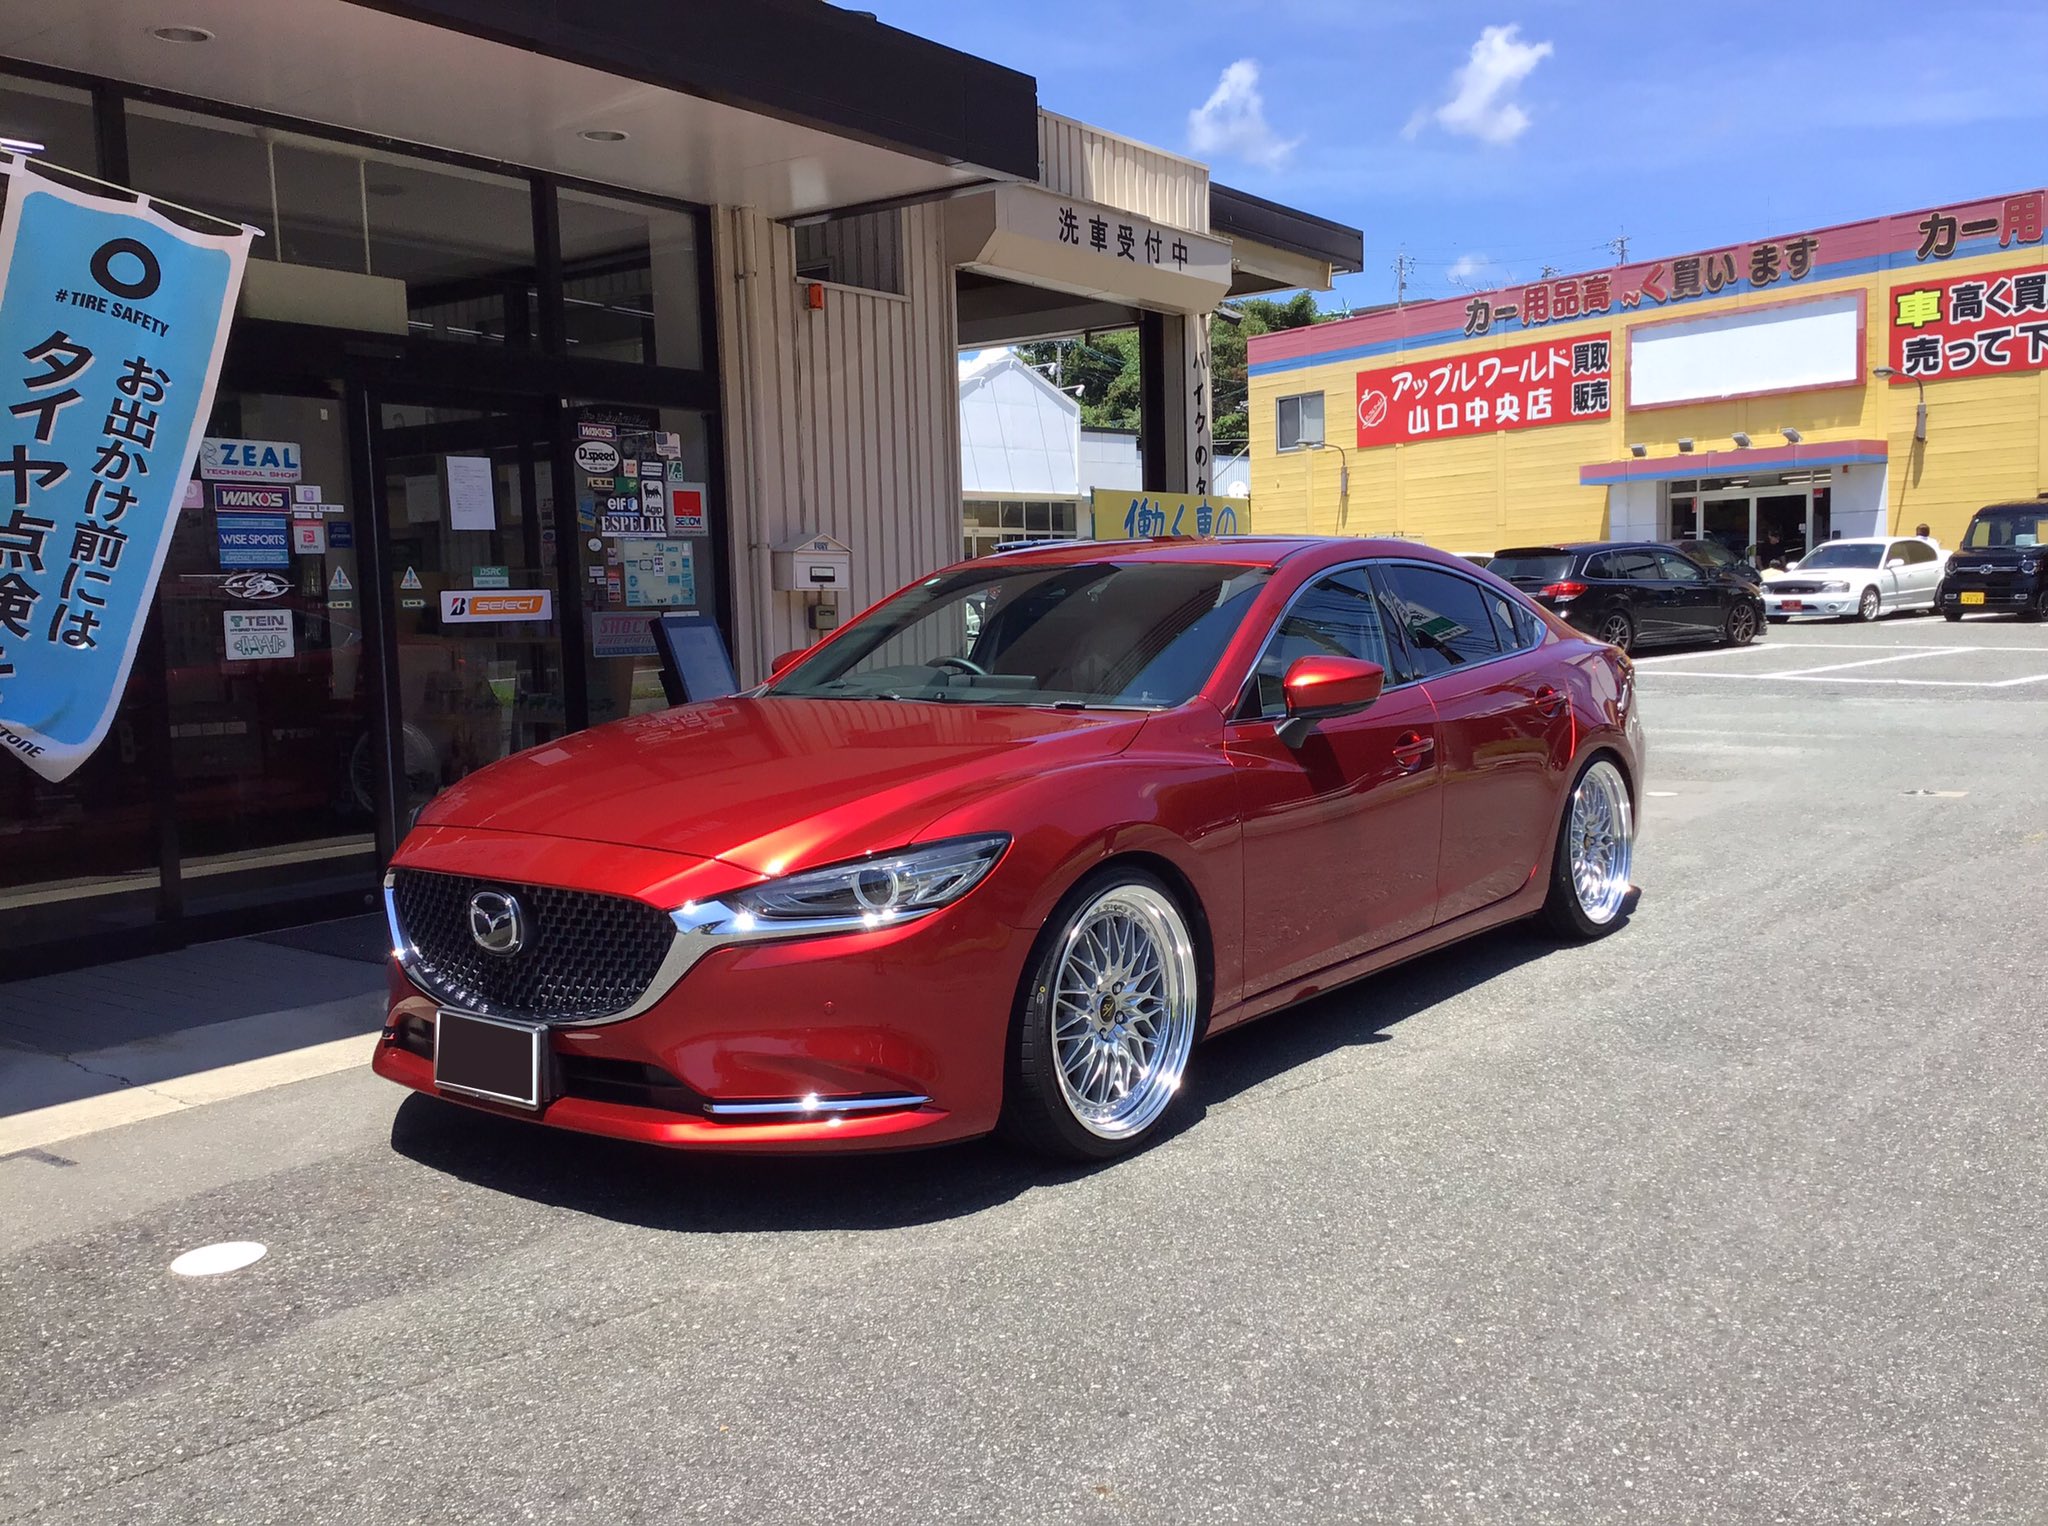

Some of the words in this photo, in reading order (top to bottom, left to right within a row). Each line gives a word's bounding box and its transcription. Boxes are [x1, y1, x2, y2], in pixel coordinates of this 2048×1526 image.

[1058, 207, 1188, 271] 洗車受付中
[110, 302, 170, 338] SAFETY
[1895, 288, 1943, 329] 車
[1391, 347, 1570, 401] アップルワールド
[1571, 340, 1609, 377] 買取
[1407, 388, 1552, 435] 山口中央店
[1570, 379, 1609, 415] 販売
[205, 468, 265, 477] TECHNICAL
[269, 471, 298, 479] SHOP
[220, 443, 299, 469] ZEAL
[0, 330, 95, 697] タイヤ点検
[47, 355, 171, 651] お出かけ前には
[607, 497, 627, 511] elf
[676, 517, 701, 525] SECOM
[1124, 497, 1237, 538] 働く車の
[220, 534, 247, 545] WISE
[248, 534, 286, 545] SPORTS
[601, 515, 666, 532] ESPELIR
[480, 567, 502, 576] DSRC
[245, 615, 284, 626] TEIN
